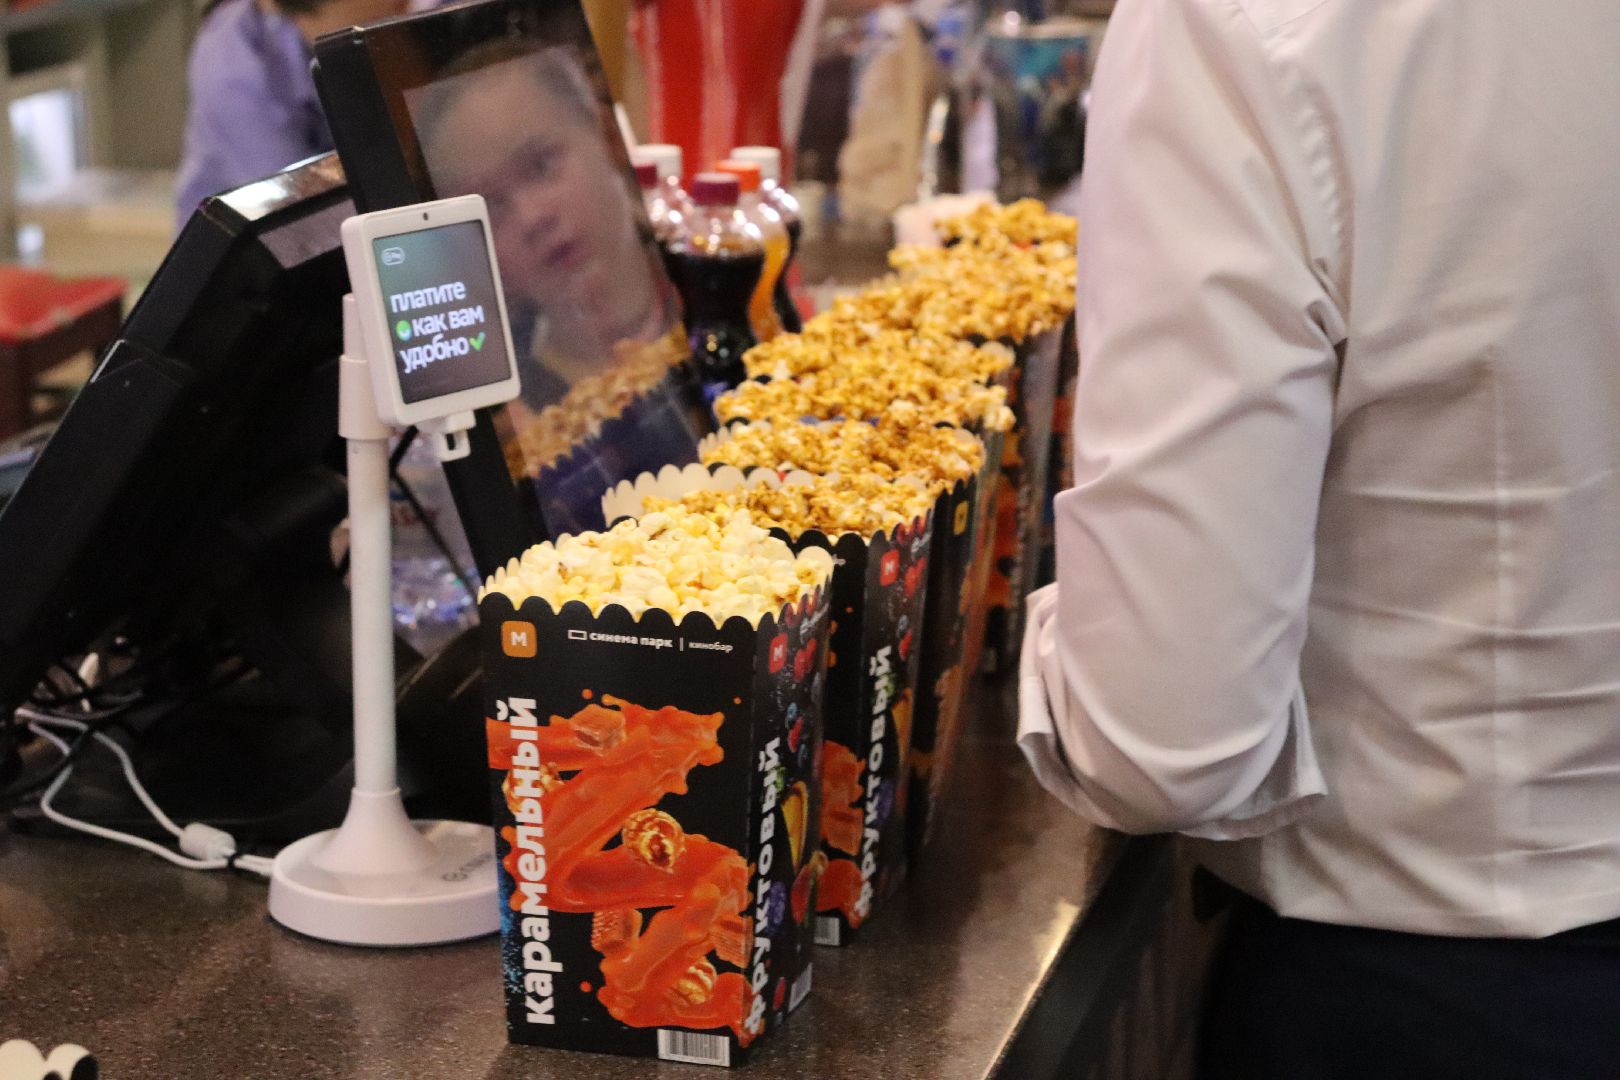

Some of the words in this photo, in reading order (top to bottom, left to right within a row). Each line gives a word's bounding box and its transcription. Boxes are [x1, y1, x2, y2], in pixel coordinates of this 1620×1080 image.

[390, 281, 466, 313] платите
[413, 313, 448, 336] как
[449, 305, 485, 329] вам
[400, 335, 470, 373] удобно
[640, 636, 673, 650] парк
[688, 640, 733, 654] кинобар
